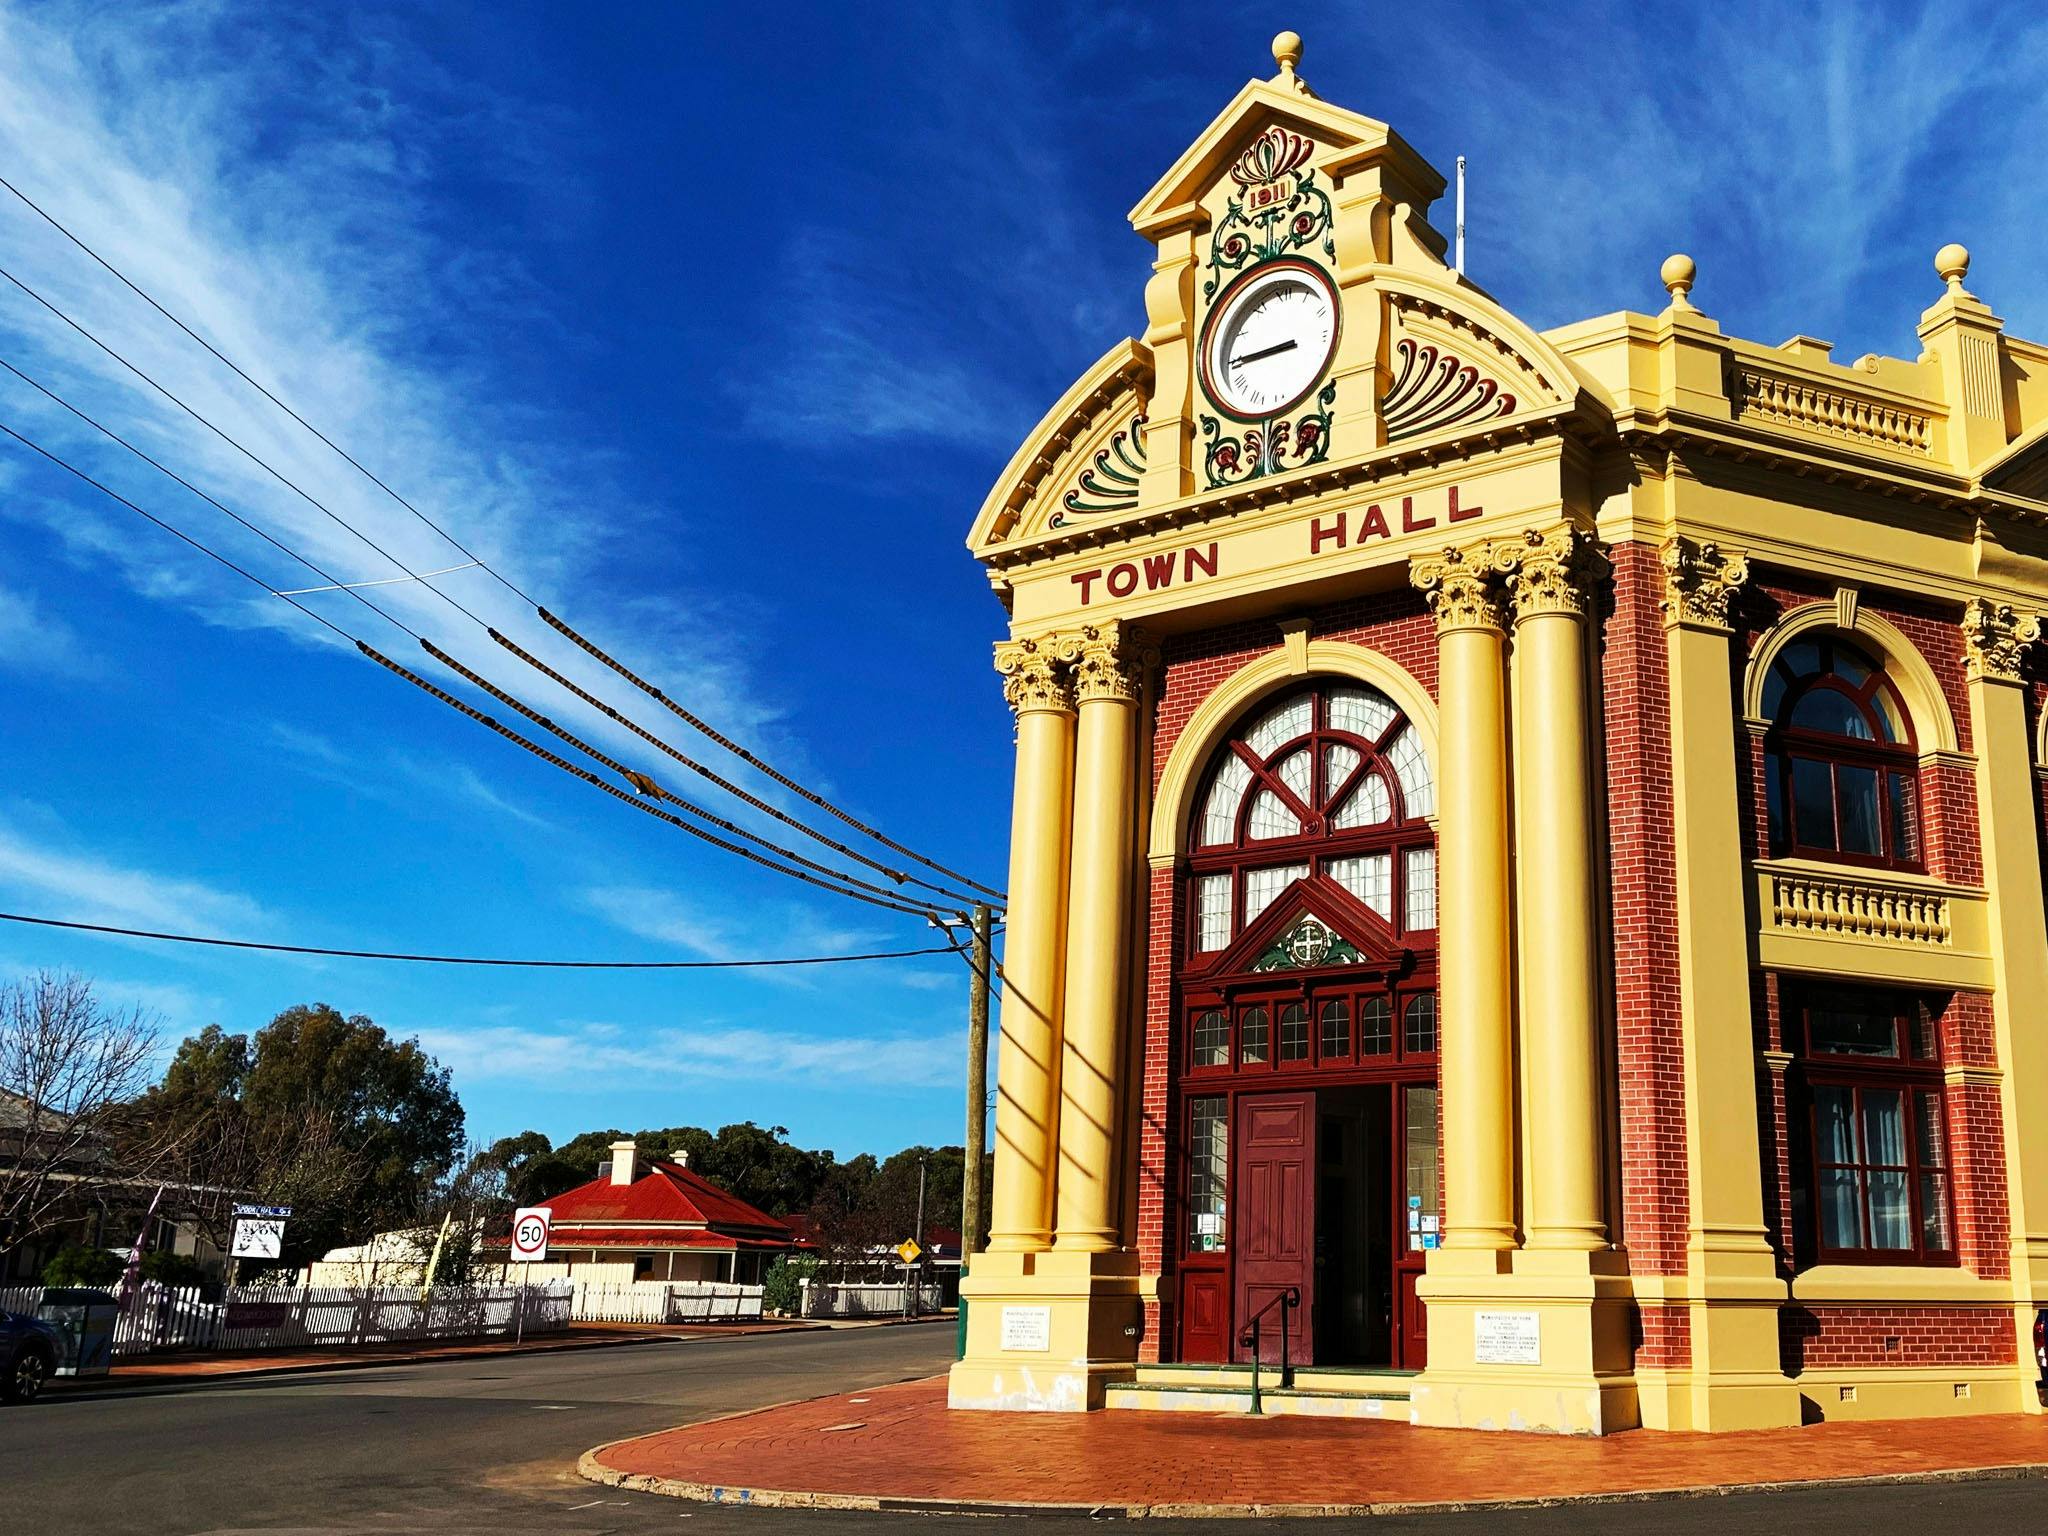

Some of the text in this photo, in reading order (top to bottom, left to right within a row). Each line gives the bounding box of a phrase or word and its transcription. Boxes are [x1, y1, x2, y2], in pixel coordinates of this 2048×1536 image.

[1250, 182, 1286, 208] 1911
[1071, 485, 1483, 605] TOWN HALL
[520, 1225, 542, 1243] 50
